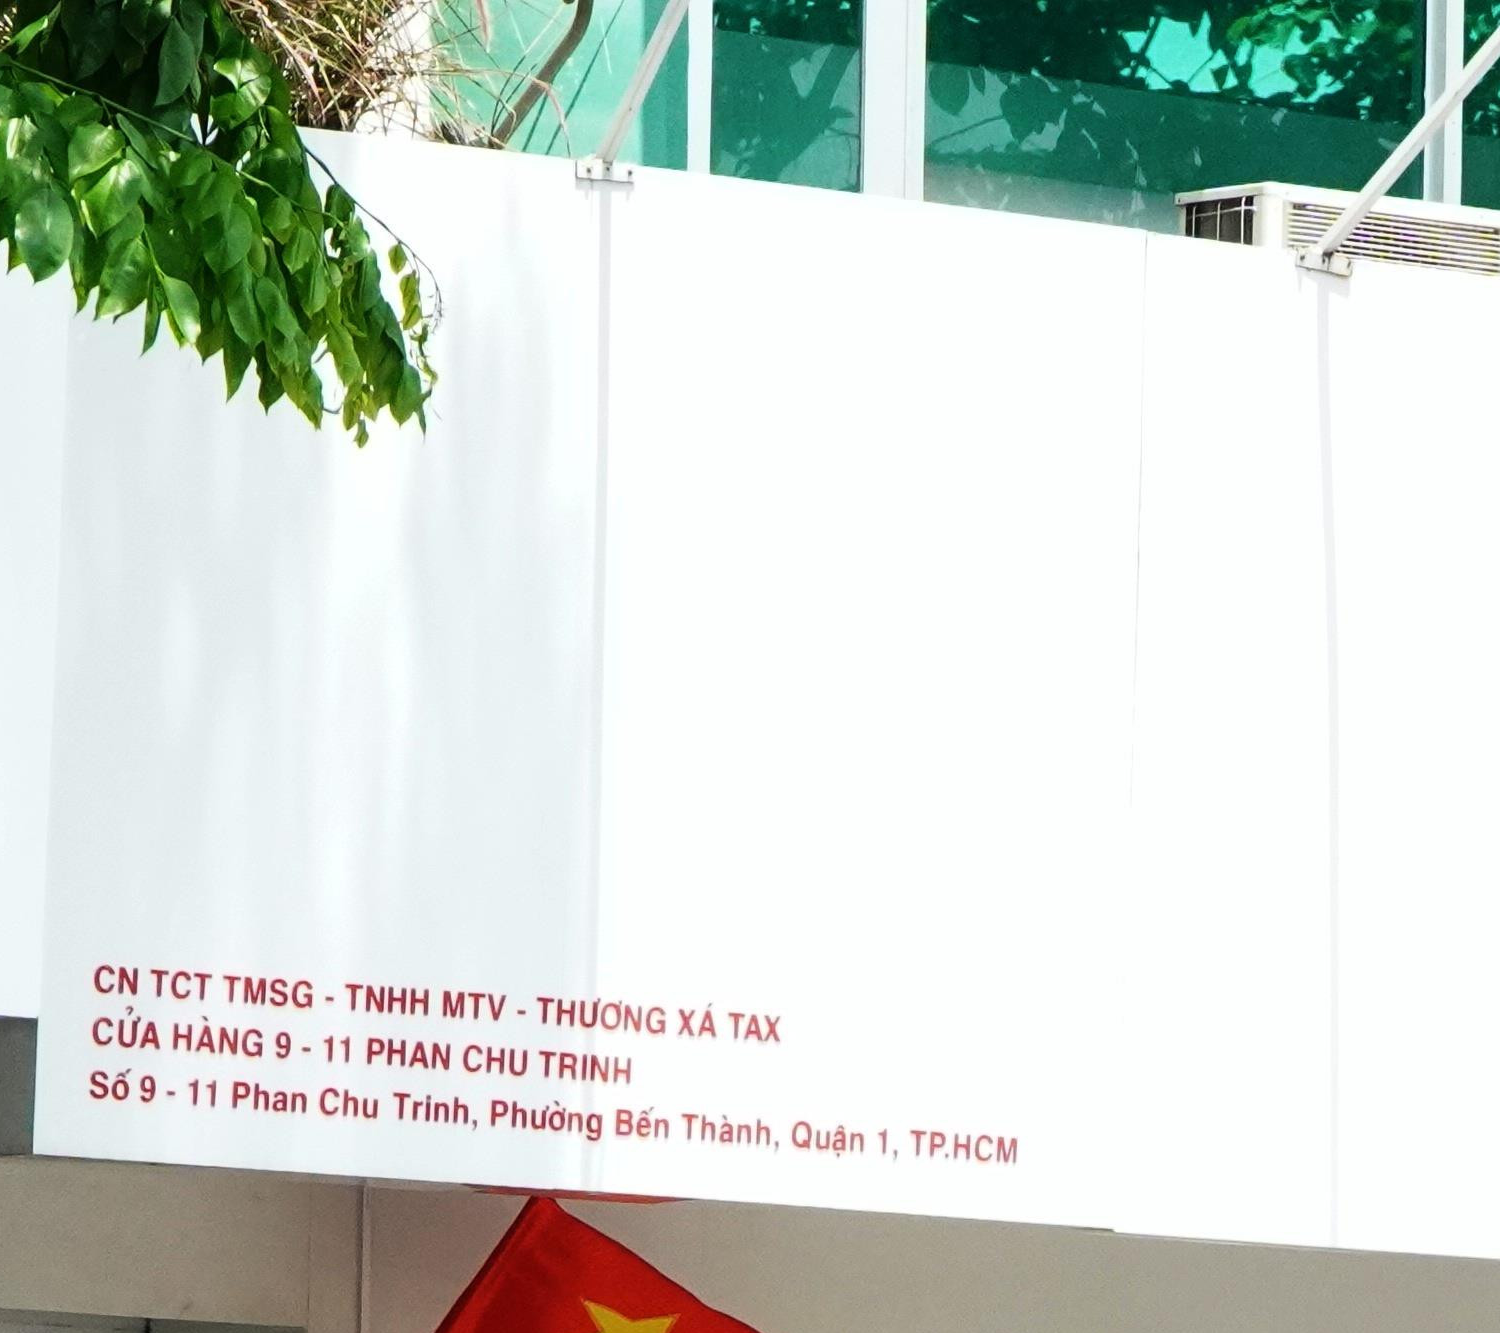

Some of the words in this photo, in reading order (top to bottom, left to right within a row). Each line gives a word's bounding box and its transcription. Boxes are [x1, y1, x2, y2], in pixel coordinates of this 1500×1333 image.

[94, 965, 138, 995] CN
[150, 968, 212, 1001] TCT
[222, 975, 313, 1008] TMSG
[345, 984, 429, 1016] TNHH
[442, 991, 506, 1022] MTV
[537, 997, 666, 1035] THƯƠNG
[678, 1003, 716, 1038] XÁ
[728, 1012, 781, 1043] TAX
[92, 1006, 161, 1051] CỬA
[172, 1016, 264, 1058] HÀNG
[275, 1031, 292, 1059] 9
[324, 1036, 351, 1063] 11
[366, 1038, 451, 1071] PHAN
[462, 1044, 528, 1077] CHU
[538, 1050, 633, 1084] TRINH
[89, 1069, 130, 1101] Số
[139, 1074, 156, 1102] 9
[188, 1078, 218, 1108] 11
[231, 1081, 307, 1114] Phan
[319, 1088, 378, 1120] Chu
[393, 1092, 478, 1131] Trinh,
[490, 1099, 603, 1142] Phường
[614, 1107, 669, 1139] Bến
[682, 1112, 780, 1151] Thành,
[791, 1120, 864, 1159] Quận
[878, 1128, 899, 1161] 1,
[909, 1129, 1018, 1164] TP.HCM
